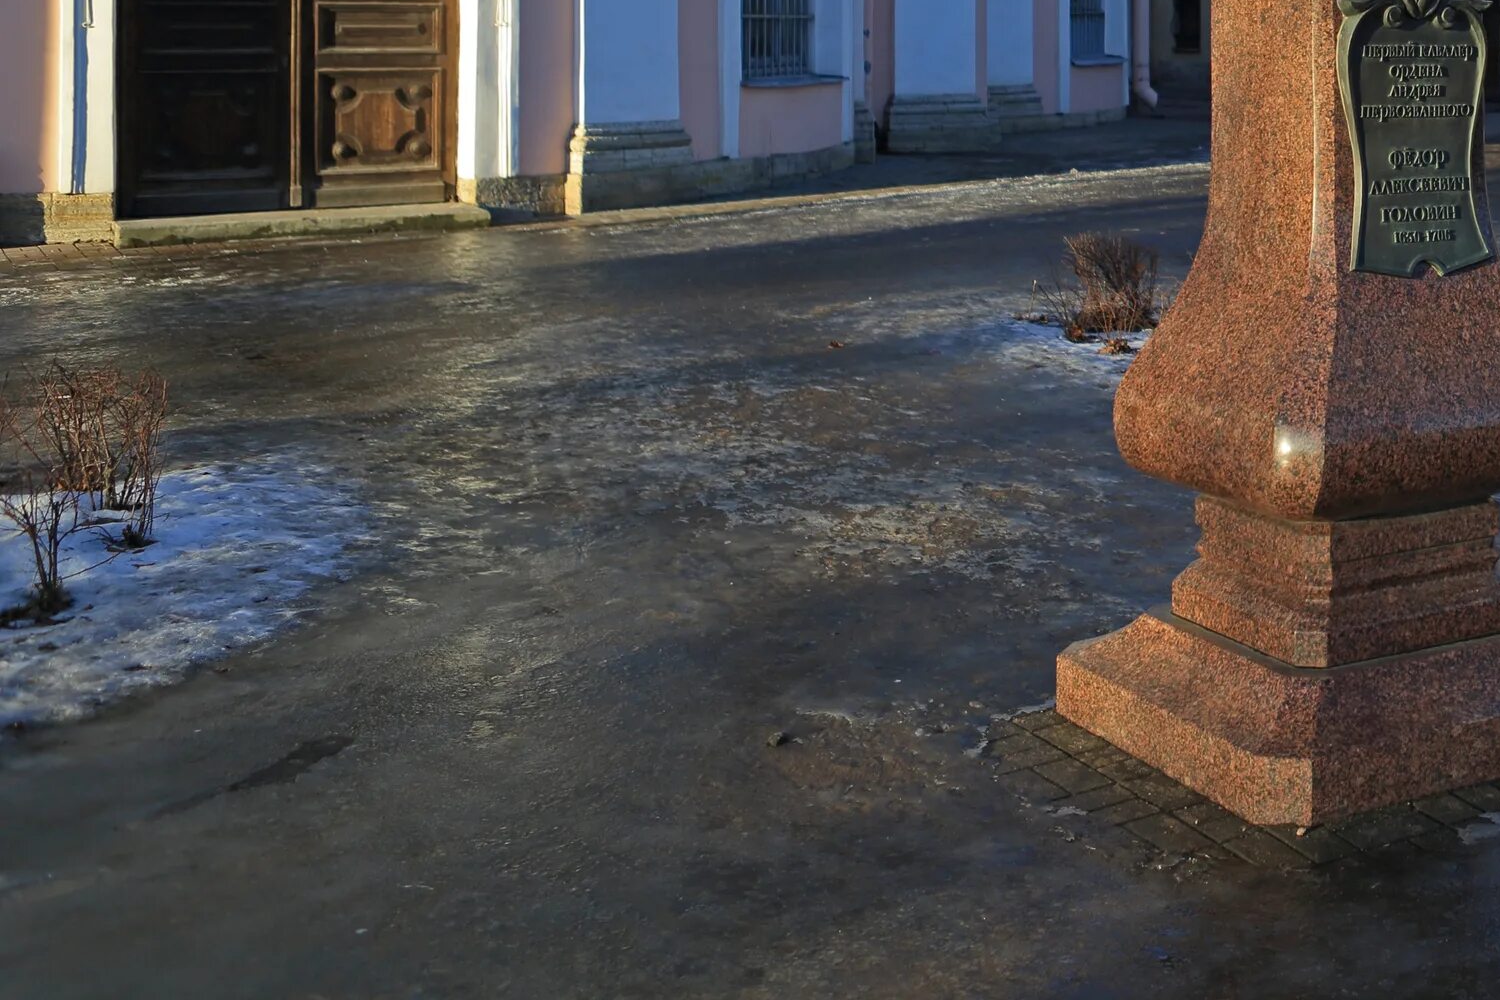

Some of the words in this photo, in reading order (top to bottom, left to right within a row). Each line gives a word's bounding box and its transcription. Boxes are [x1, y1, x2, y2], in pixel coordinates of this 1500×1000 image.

[1362, 41, 1415, 62] ПЕРВЫЙ
[1418, 43, 1474, 62] КАВАЛЕР
[1388, 64, 1443, 82] ОРДЕНА
[1387, 83, 1441, 101] АНДРЕЯ
[1360, 103, 1471, 122] ПЕРВОЗВАННОГО
[1368, 176, 1466, 196] АЛЕКСЕЕВИЧ
[1380, 205, 1457, 223] ГОЛОВИН
